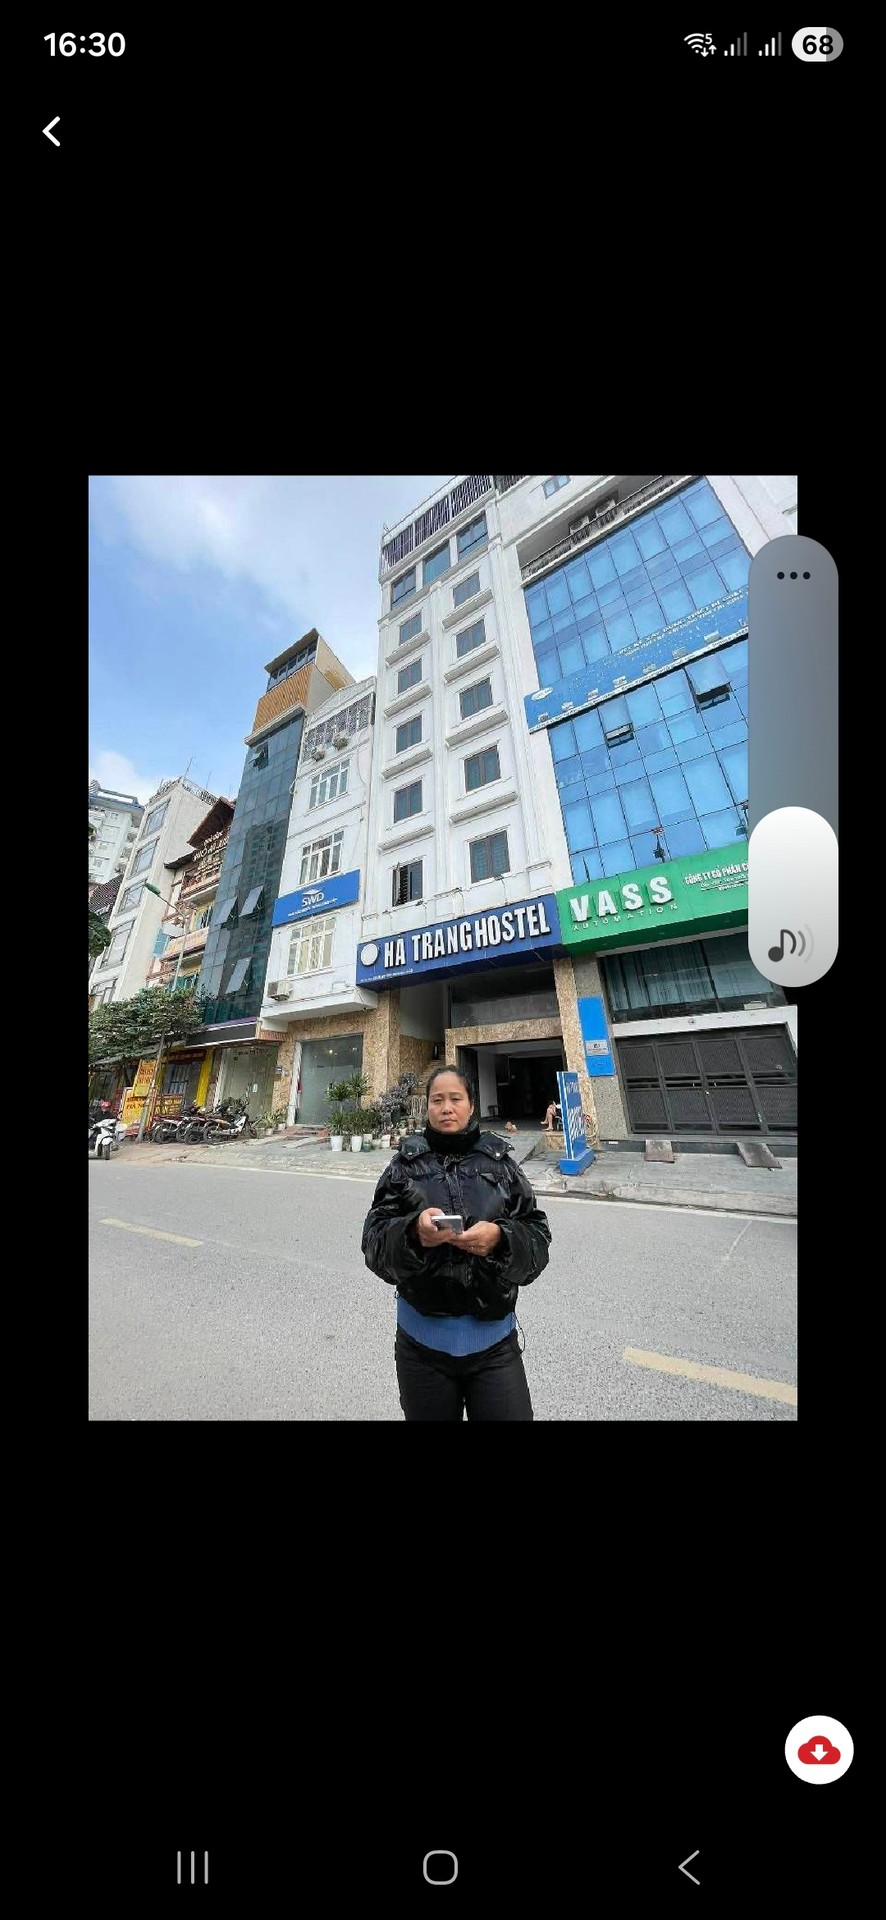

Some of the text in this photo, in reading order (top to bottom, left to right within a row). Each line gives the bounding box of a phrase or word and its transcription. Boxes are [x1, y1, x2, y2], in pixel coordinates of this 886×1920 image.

[301, 892, 325, 907] SWD
[569, 876, 674, 922] VASS
[572, 902, 679, 932] AUTOMATION
